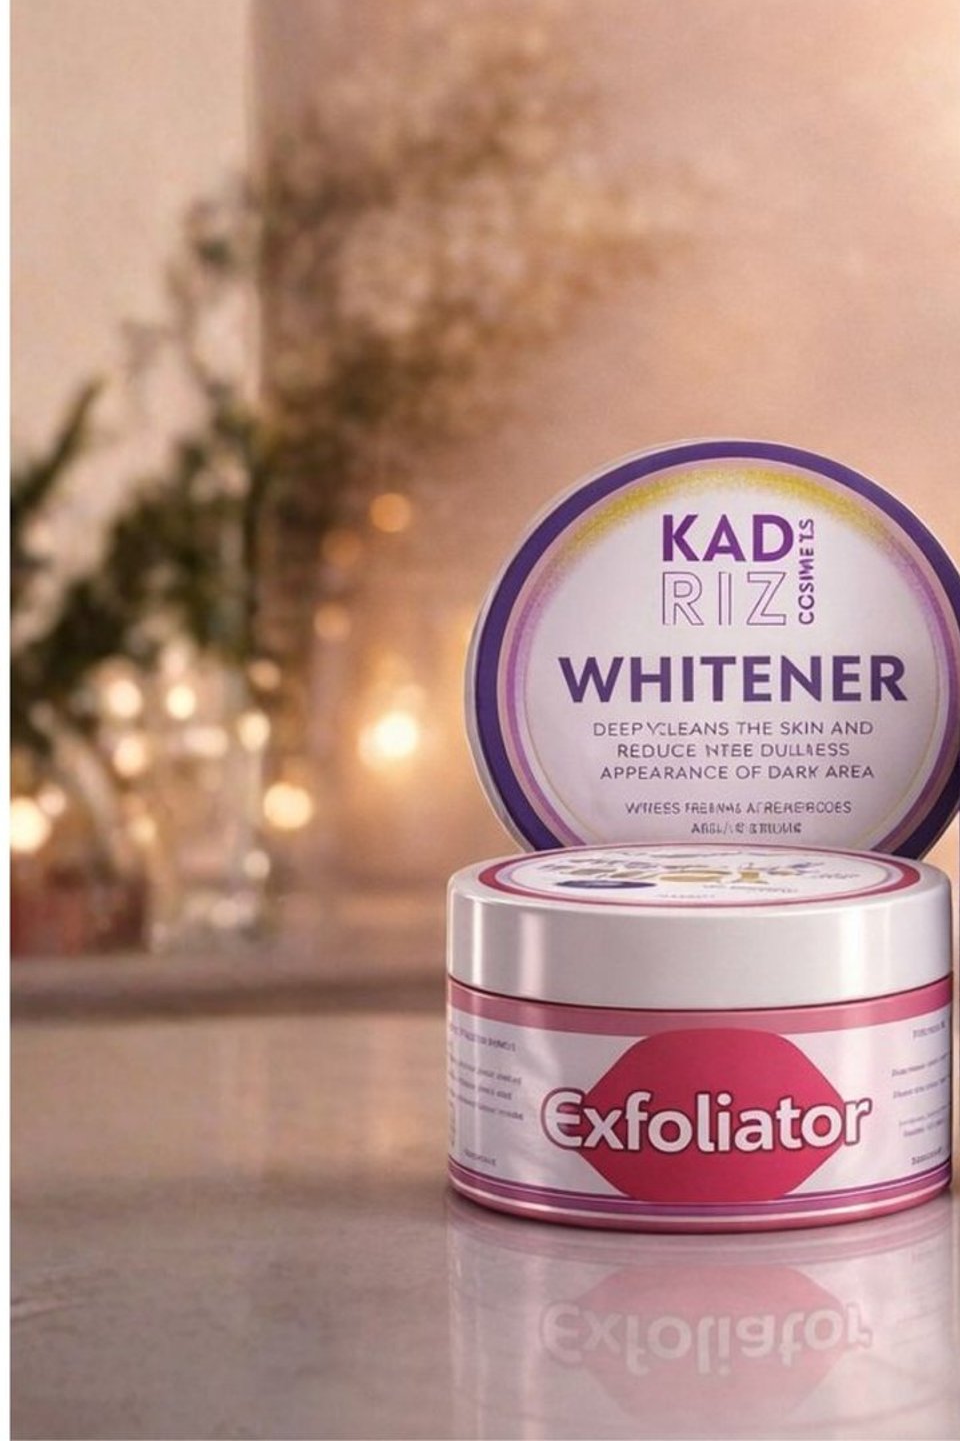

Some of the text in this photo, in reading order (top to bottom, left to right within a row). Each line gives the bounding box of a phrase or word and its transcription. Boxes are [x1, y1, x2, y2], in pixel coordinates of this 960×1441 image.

[663, 514, 794, 562] KAD
[662, 571, 788, 626] RIZ
[559, 655, 908, 703] WHITENER
[617, 743, 696, 758] REDUCE
[736, 721, 773, 736] THE
[780, 720, 824, 735] SKIN
[831, 720, 874, 735] AND
[600, 765, 875, 780] APPEARANCE OF DARK AREA
[541, 1088, 873, 1154] Exfoliator
